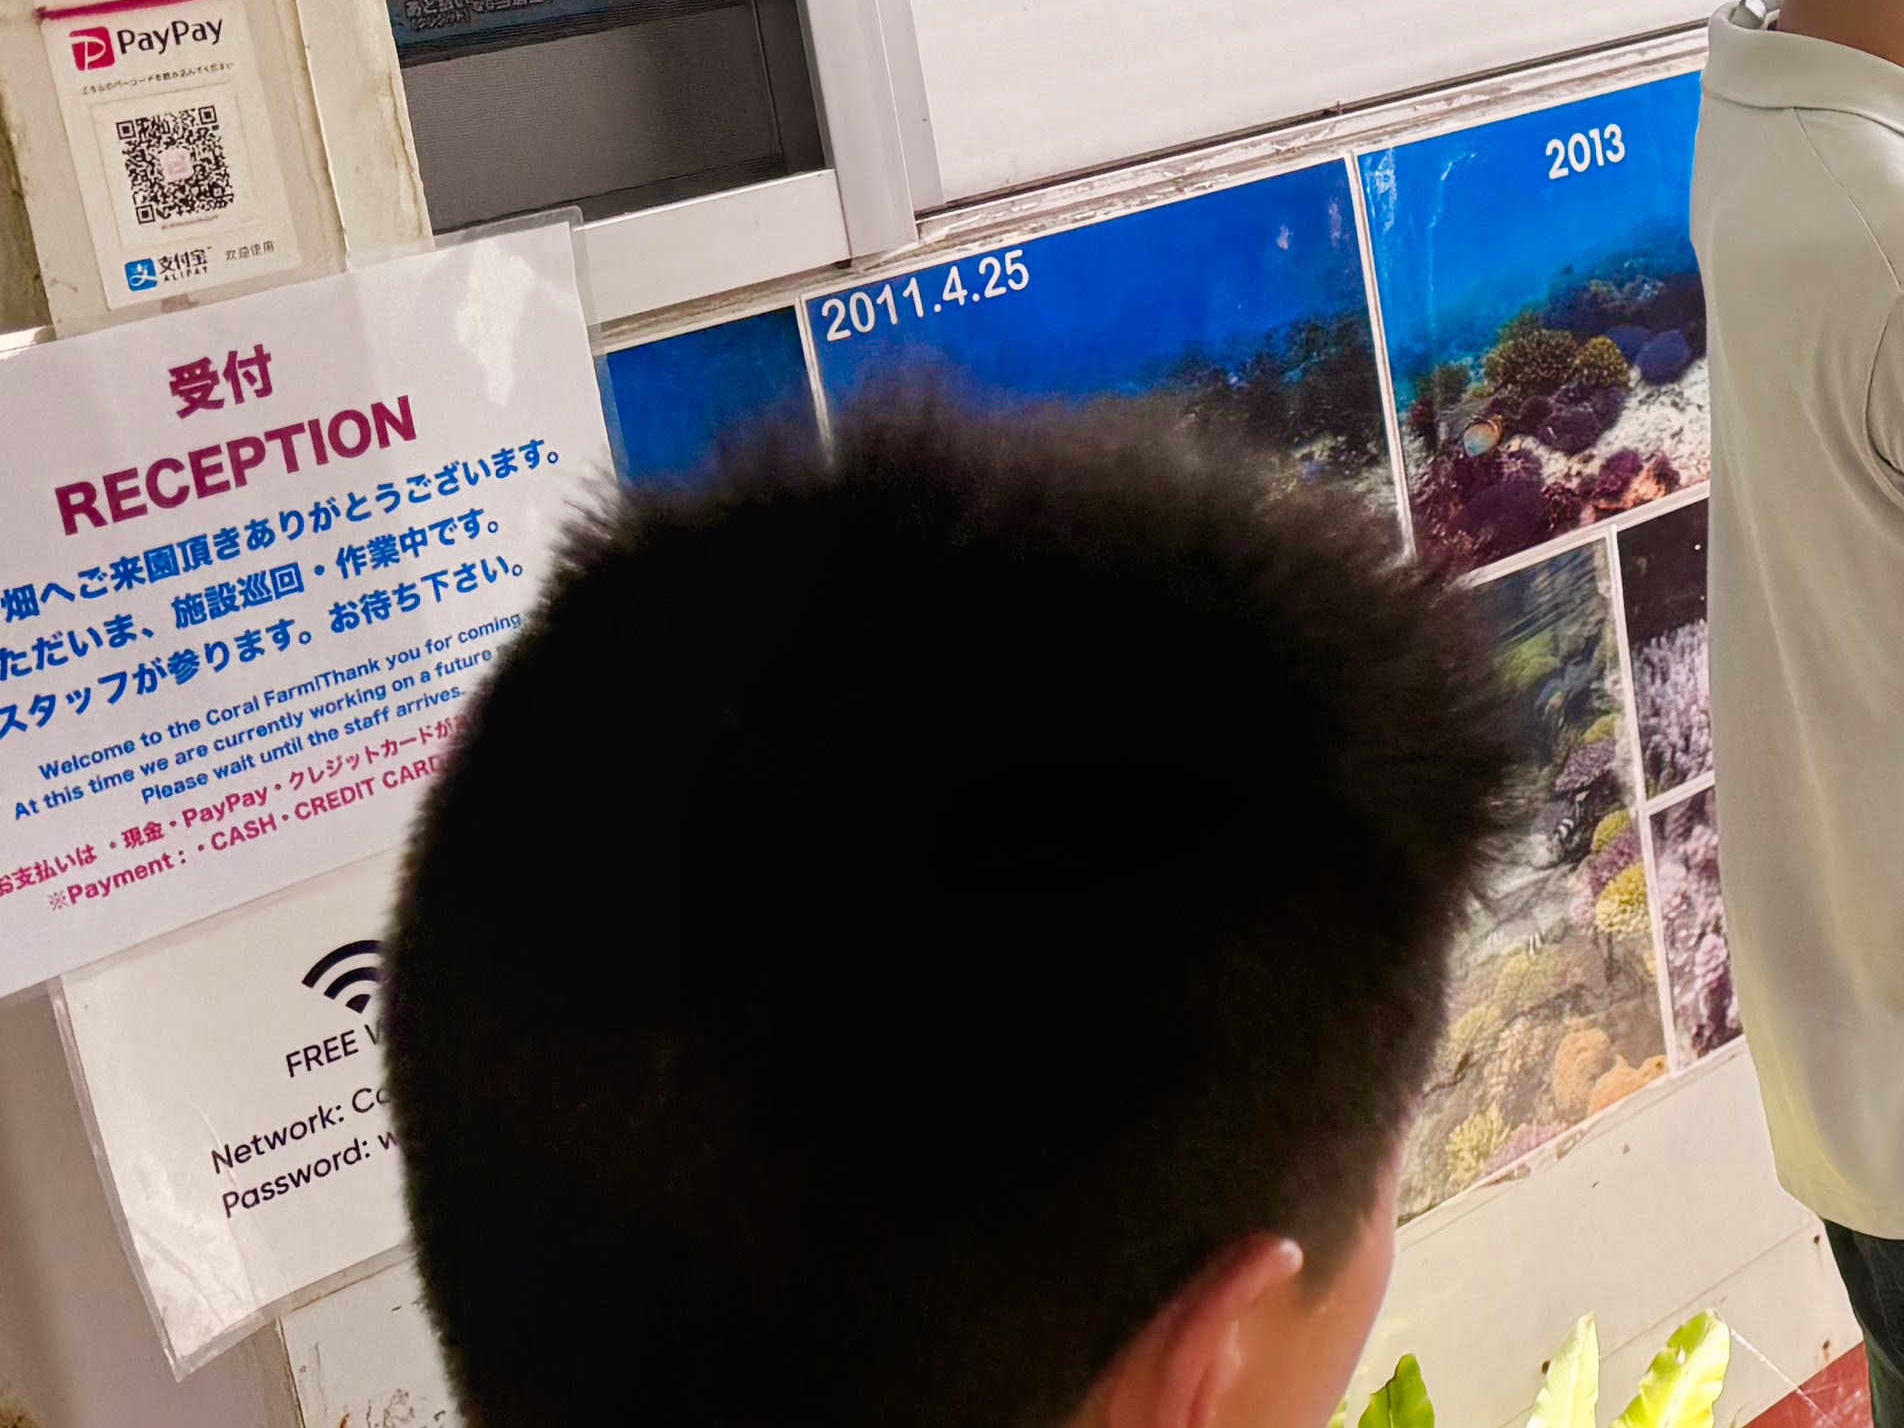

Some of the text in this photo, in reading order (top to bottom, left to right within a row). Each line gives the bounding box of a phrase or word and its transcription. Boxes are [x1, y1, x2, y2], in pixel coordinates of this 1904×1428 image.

[116, 18, 223, 55] PayPay
[1545, 122, 1627, 180] 2013
[157, 248, 208, 275] 支付宝
[163, 265, 208, 283] ALIPAY
[820, 249, 1031, 342] 2011.4.25
[167, 343, 273, 420] 受付
[54, 394, 417, 536] RECEPTION
[0, 439, 559, 624] 畑へご来園頂きありがとうございます。
[0, 507, 499, 680] ただいま、施設巡回・作業中です。
[15, 650, 492, 821] At this time we are currently working on a future
[38, 739, 136, 781] Welcome
[139, 731, 163, 748] to
[166, 718, 201, 739] the
[205, 695, 260, 726] Coral
[263, 657, 381, 708] Farm!Thank
[385, 647, 421, 672] you
[424, 635, 453, 655] for
[140, 686, 467, 805] Please wait until the staff arrives.
[285, 1029, 359, 1079] FREE
[211, 1104, 345, 1175] Network:
[222, 1137, 371, 1219] Password:
